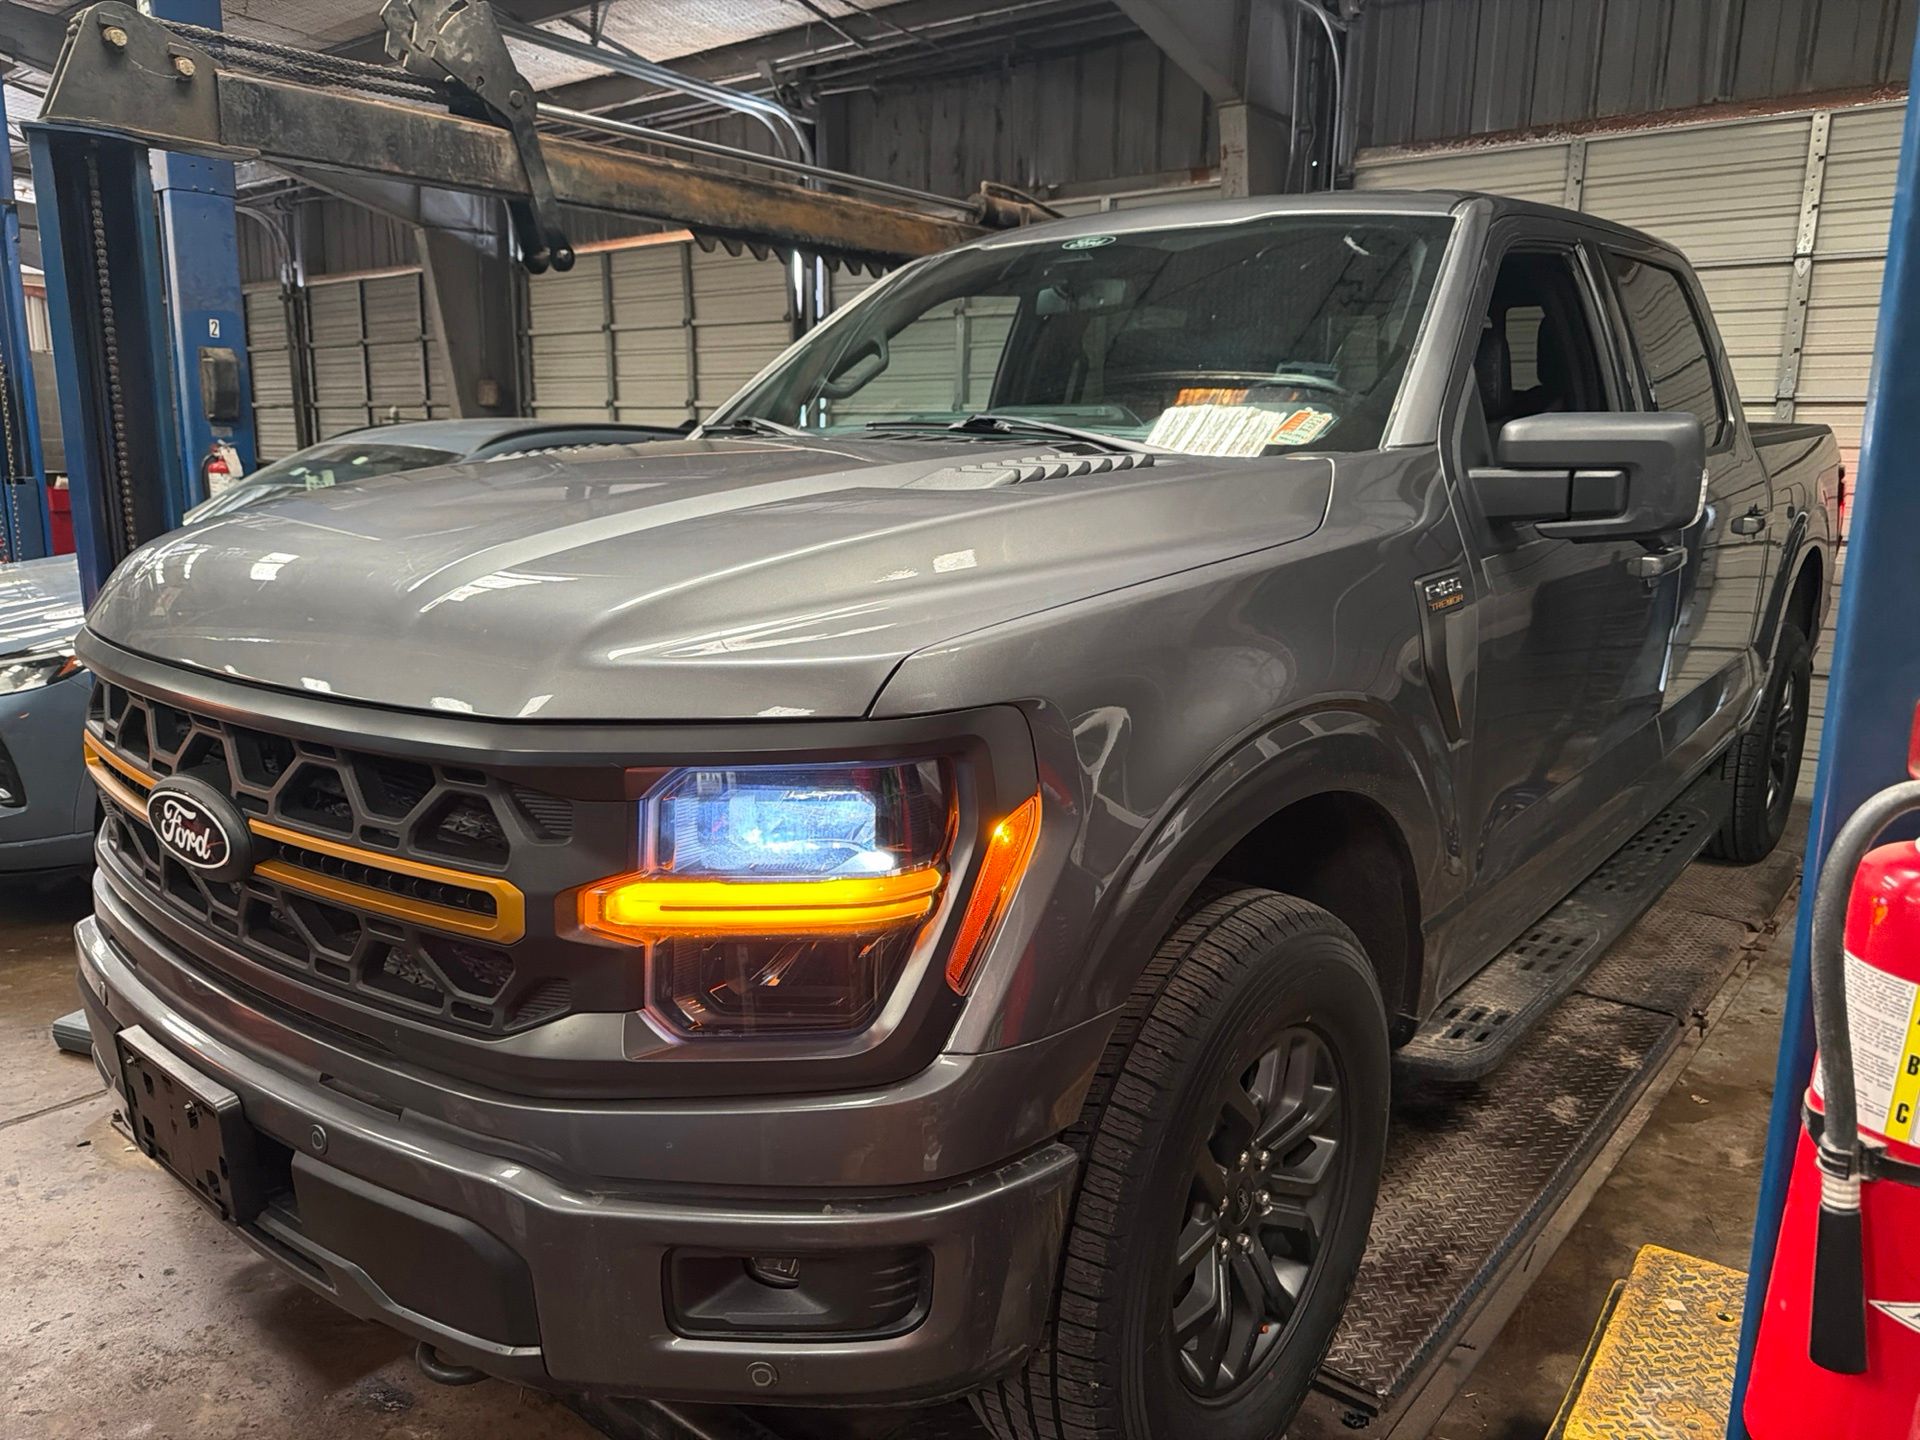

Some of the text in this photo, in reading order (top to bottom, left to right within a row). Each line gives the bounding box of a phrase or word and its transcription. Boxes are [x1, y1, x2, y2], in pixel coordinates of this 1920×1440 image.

[211, 320, 218, 337] 2
[1431, 593, 1464, 611] TREMOR
[161, 799, 212, 860] Ford
[1907, 1054, 1920, 1076] B
[1896, 1103, 1909, 1124] C
